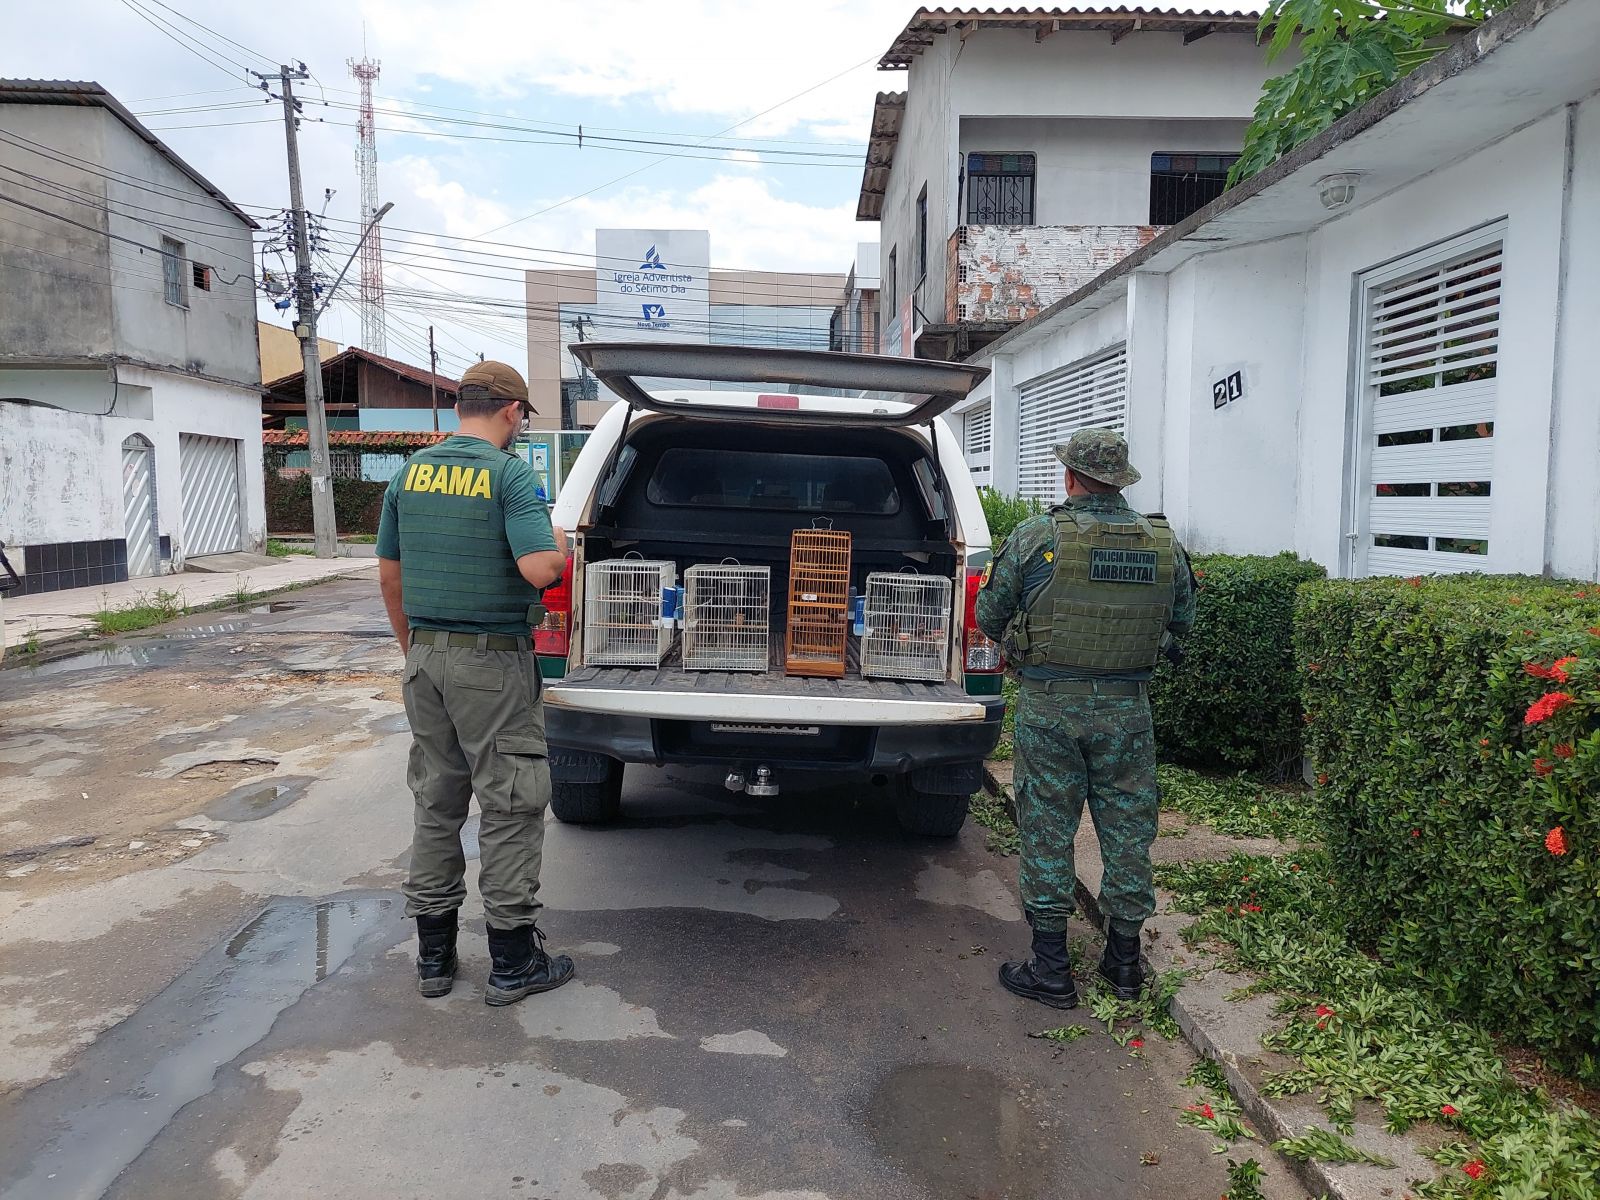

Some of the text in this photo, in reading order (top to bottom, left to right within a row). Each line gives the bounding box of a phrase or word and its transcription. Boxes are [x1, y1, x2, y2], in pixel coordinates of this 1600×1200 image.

[613, 272, 692, 283] Igreja Adventista
[620, 284, 633, 293] do
[671, 285, 686, 293] Dia
[1214, 375, 1240, 407] 21
[404, 463, 492, 499] IBAMA
[1125, 552, 1155, 564] MILITAR
[1092, 564, 1154, 581] AMBIENTAL
